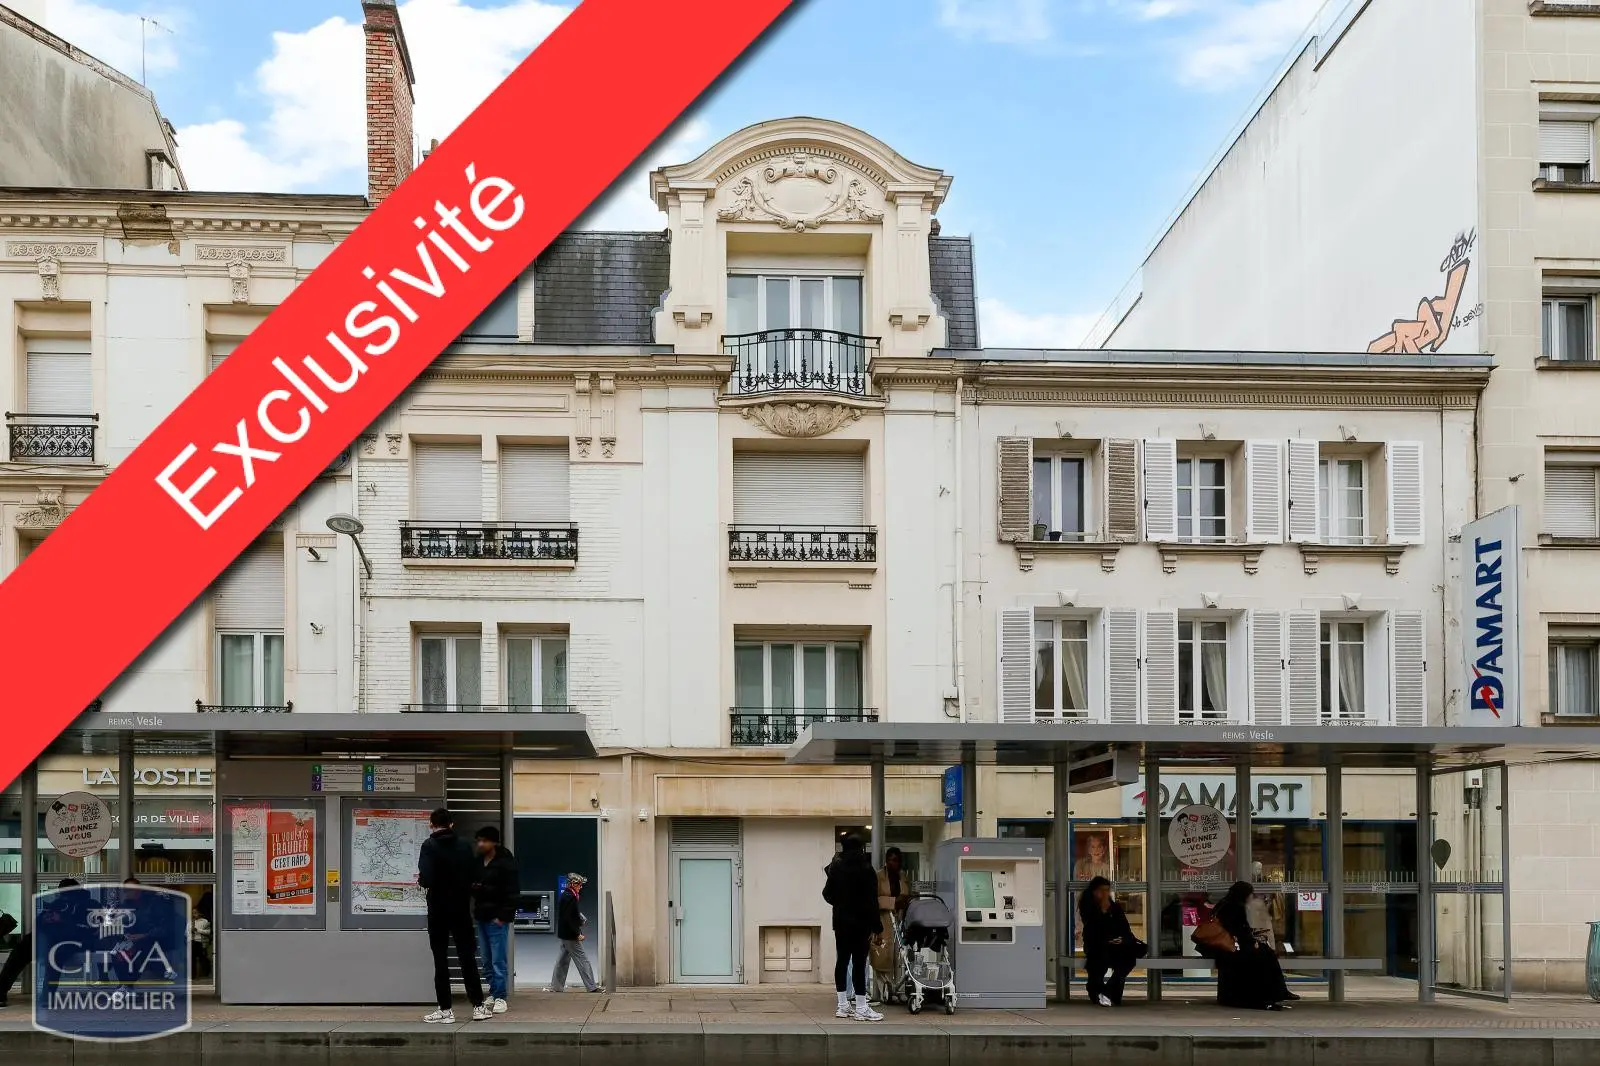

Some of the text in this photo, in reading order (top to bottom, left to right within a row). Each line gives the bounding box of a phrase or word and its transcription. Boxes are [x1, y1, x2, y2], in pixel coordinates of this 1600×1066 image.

[1471, 537, 1504, 712] DAMART
[136, 716, 163, 726] Vesle
[1222, 730, 1274, 740] REIMS Vesle
[82, 767, 119, 785] LA
[151, 815, 166, 823] DE
[169, 815, 199, 823] VILLE
[59, 822, 98, 834] ABONNEZ
[1181, 833, 1218, 845] ABONNEZ
[272, 839, 309, 856] FRAUDER
